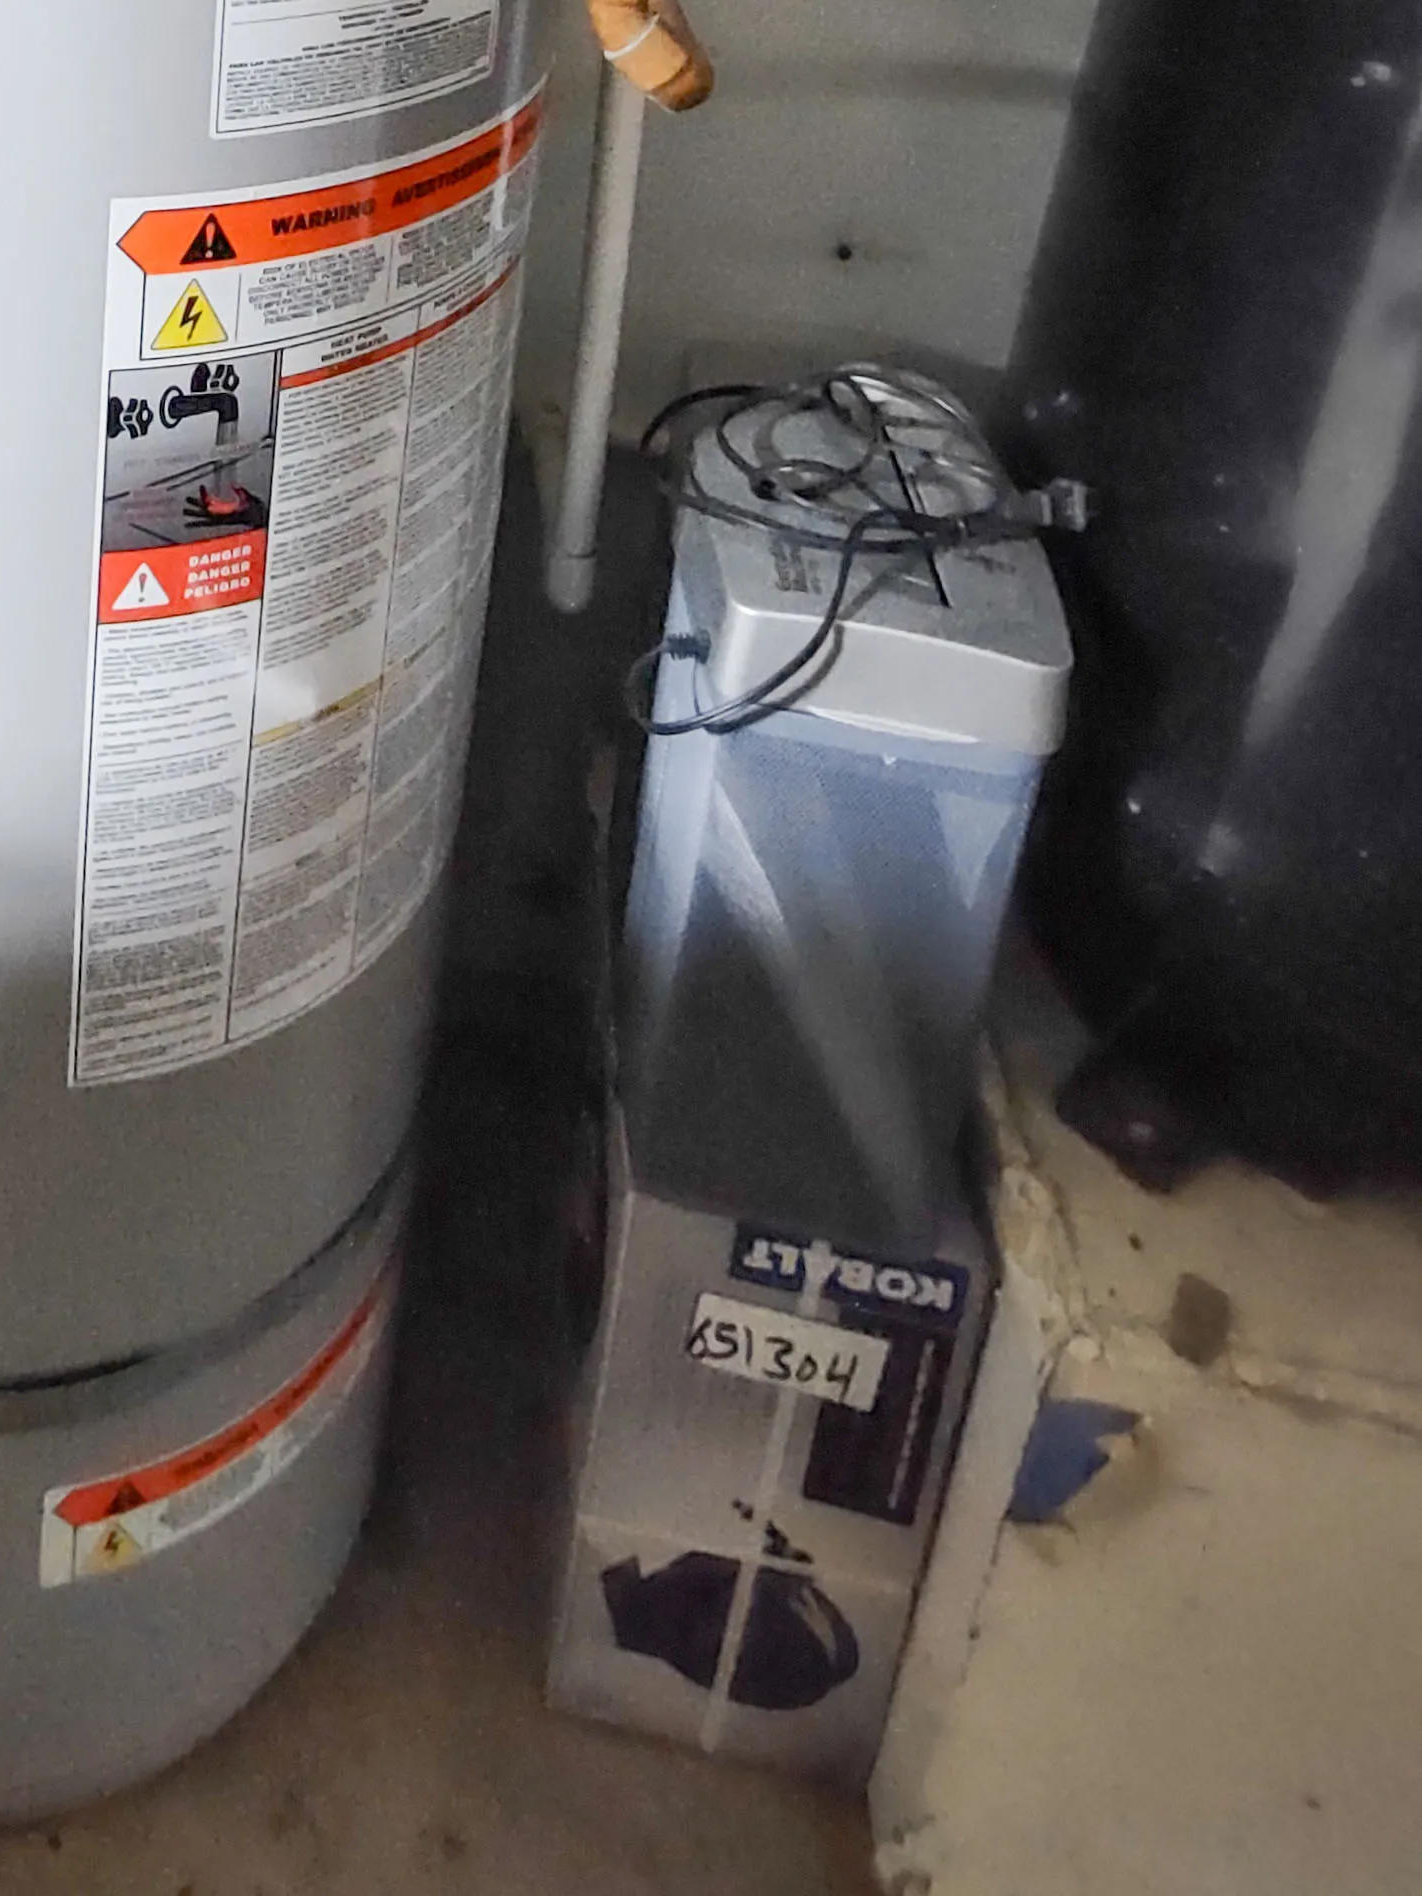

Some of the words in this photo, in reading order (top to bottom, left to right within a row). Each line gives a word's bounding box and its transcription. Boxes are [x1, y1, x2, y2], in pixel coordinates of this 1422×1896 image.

[271, 198, 377, 237] WARNING
[331, 332, 355, 349] HEAT
[189, 545, 253, 568] DANGER
[187, 561, 251, 584] DANGER
[183, 577, 251, 600] PELIGRO
